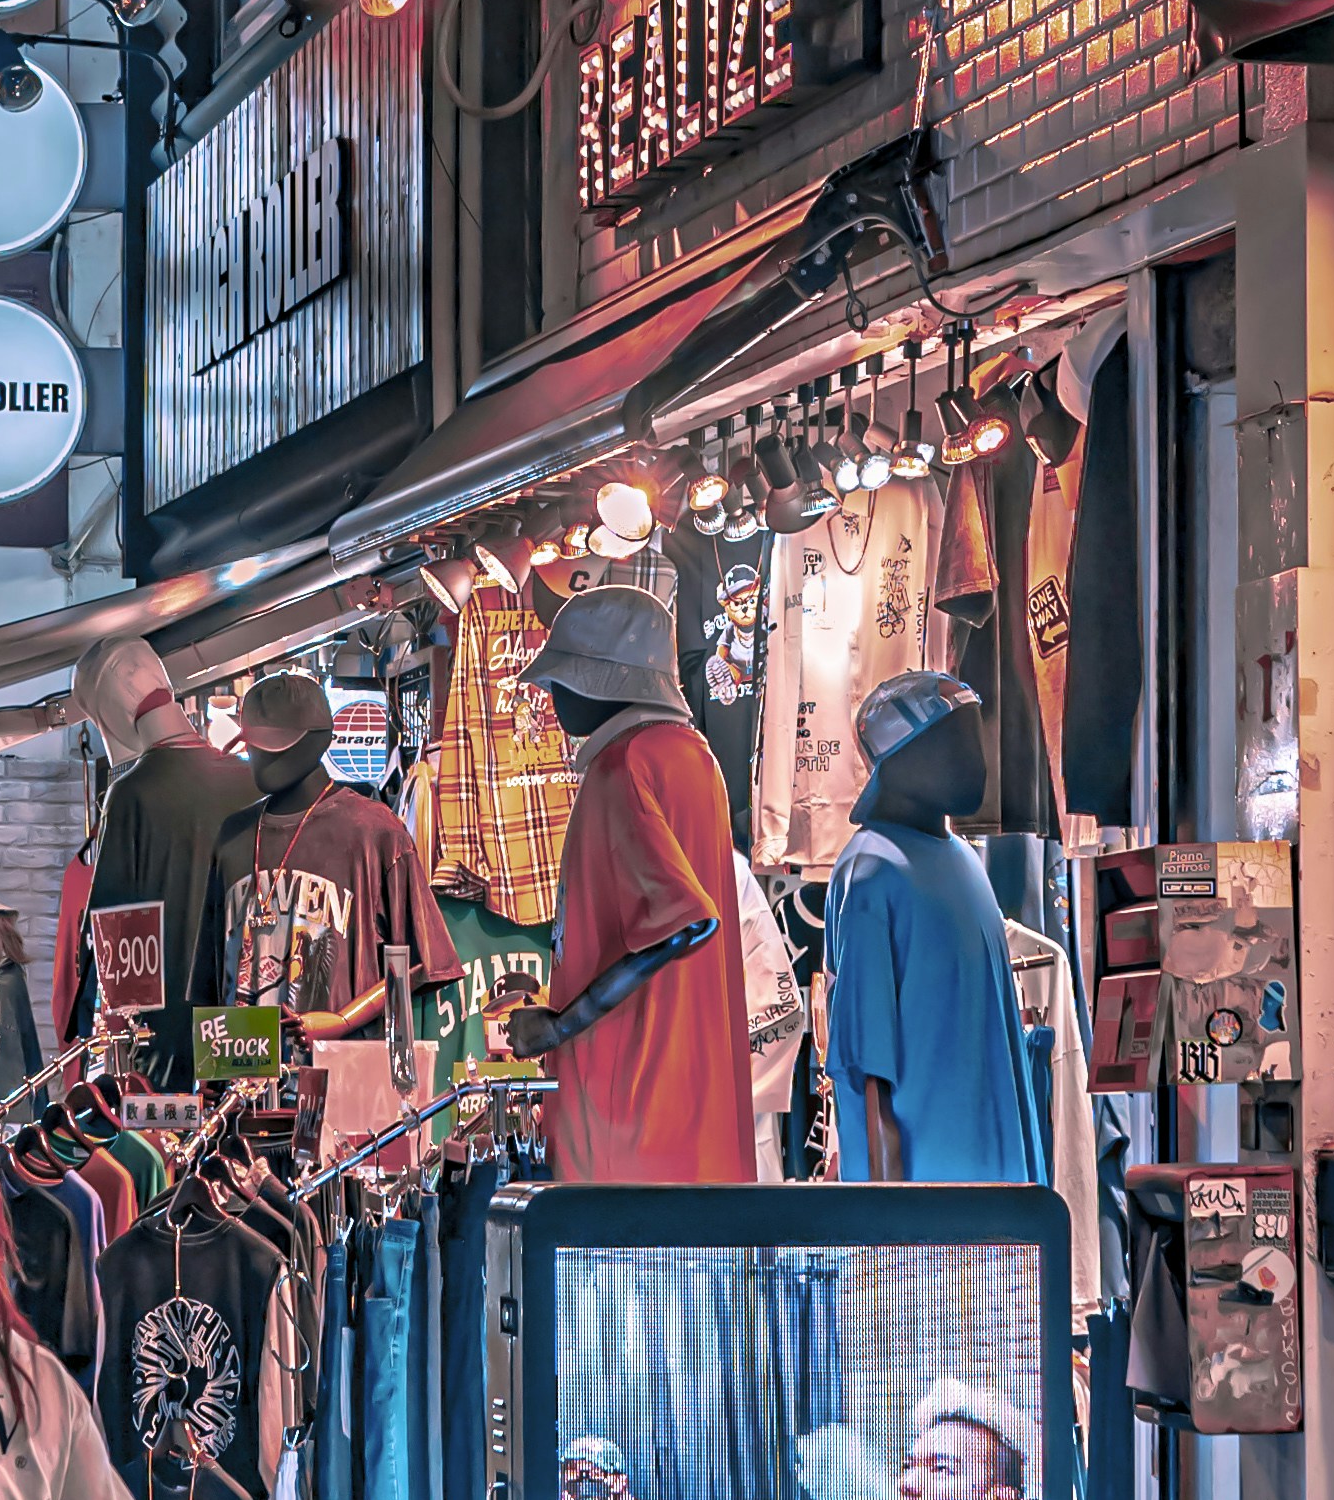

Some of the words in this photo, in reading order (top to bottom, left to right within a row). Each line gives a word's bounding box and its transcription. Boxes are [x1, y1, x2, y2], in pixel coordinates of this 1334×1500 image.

[190, 206, 247, 376] HIGH
[249, 136, 343, 336] ROLLER
[1030, 584, 1056, 615] ONE
[485, 610, 523, 633] THE
[1033, 600, 1060, 629] WAY
[505, 772, 548, 788] LOOKING
[549, 772, 580, 785] GOOD
[200, 1014, 229, 1043] RE
[210, 1037, 271, 1058] STOCK
[125, 1102, 198, 1122] 数量限定
